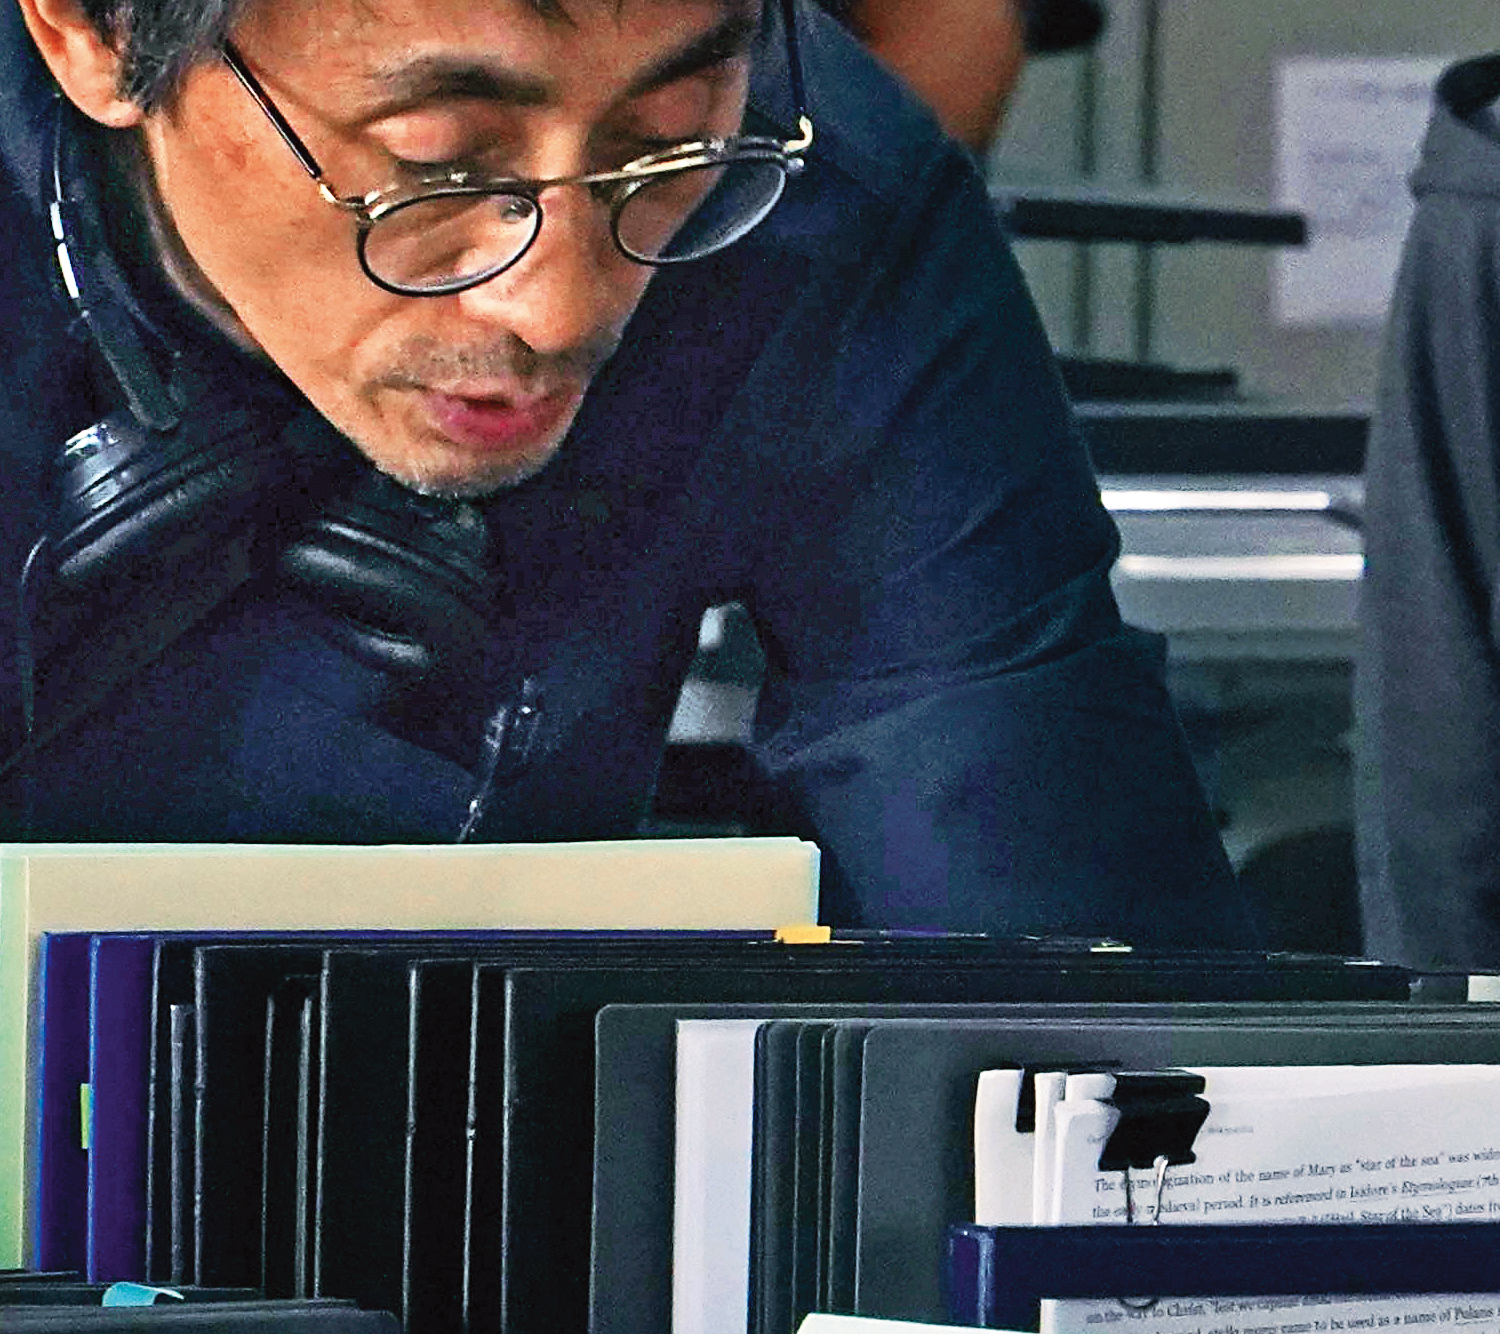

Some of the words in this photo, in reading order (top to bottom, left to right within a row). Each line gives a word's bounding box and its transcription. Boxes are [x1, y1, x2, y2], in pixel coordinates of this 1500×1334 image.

[1219, 1170, 1231, 1184] of
[1236, 1169, 1254, 1183] the
[1294, 1164, 1305, 1178] of
[1309, 1163, 1335, 1178] Mary
[1385, 1158, 1396, 1170] of
[1400, 1154, 1416, 1167] the
[1449, 1151, 1470, 1164] was
[1330, 1318, 1344, 1331] be
[1347, 1313, 1374, 1327] used
[1404, 1313, 1436, 1325] name
[1439, 1308, 1452, 1322] of
